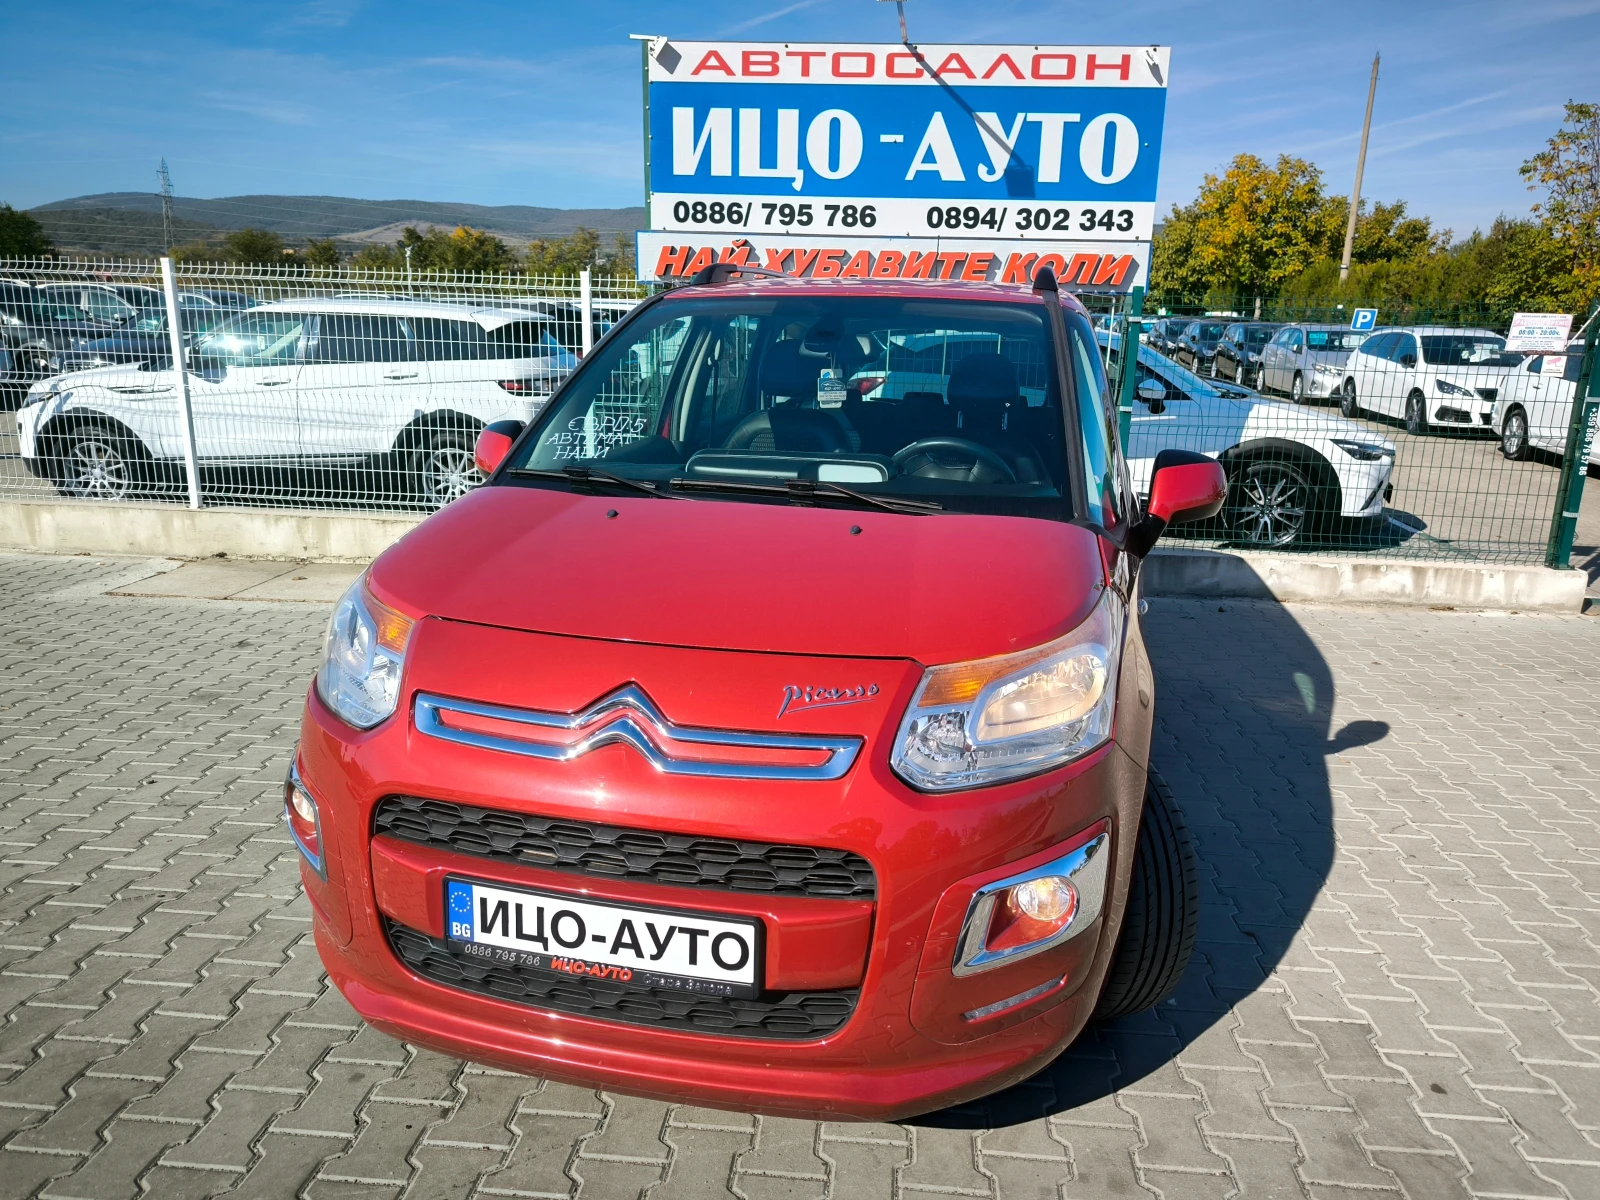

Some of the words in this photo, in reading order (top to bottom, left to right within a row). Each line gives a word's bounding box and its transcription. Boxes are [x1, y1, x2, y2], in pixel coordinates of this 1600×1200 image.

[690, 49, 1131, 81] АВТОСАЛОН
[761, 203, 814, 226] 795
[824, 204, 877, 228] 786
[1015, 208, 1070, 231] 302
[1079, 209, 1134, 232] 343
[1584, 428, 1595, 442] 886
[452, 921, 471, 939] BG
[479, 896, 750, 971] ИЦО-АУТО
[495, 949, 516, 962] 795
[519, 952, 541, 966] 786
[551, 956, 632, 981] ИЦО-АУТО
